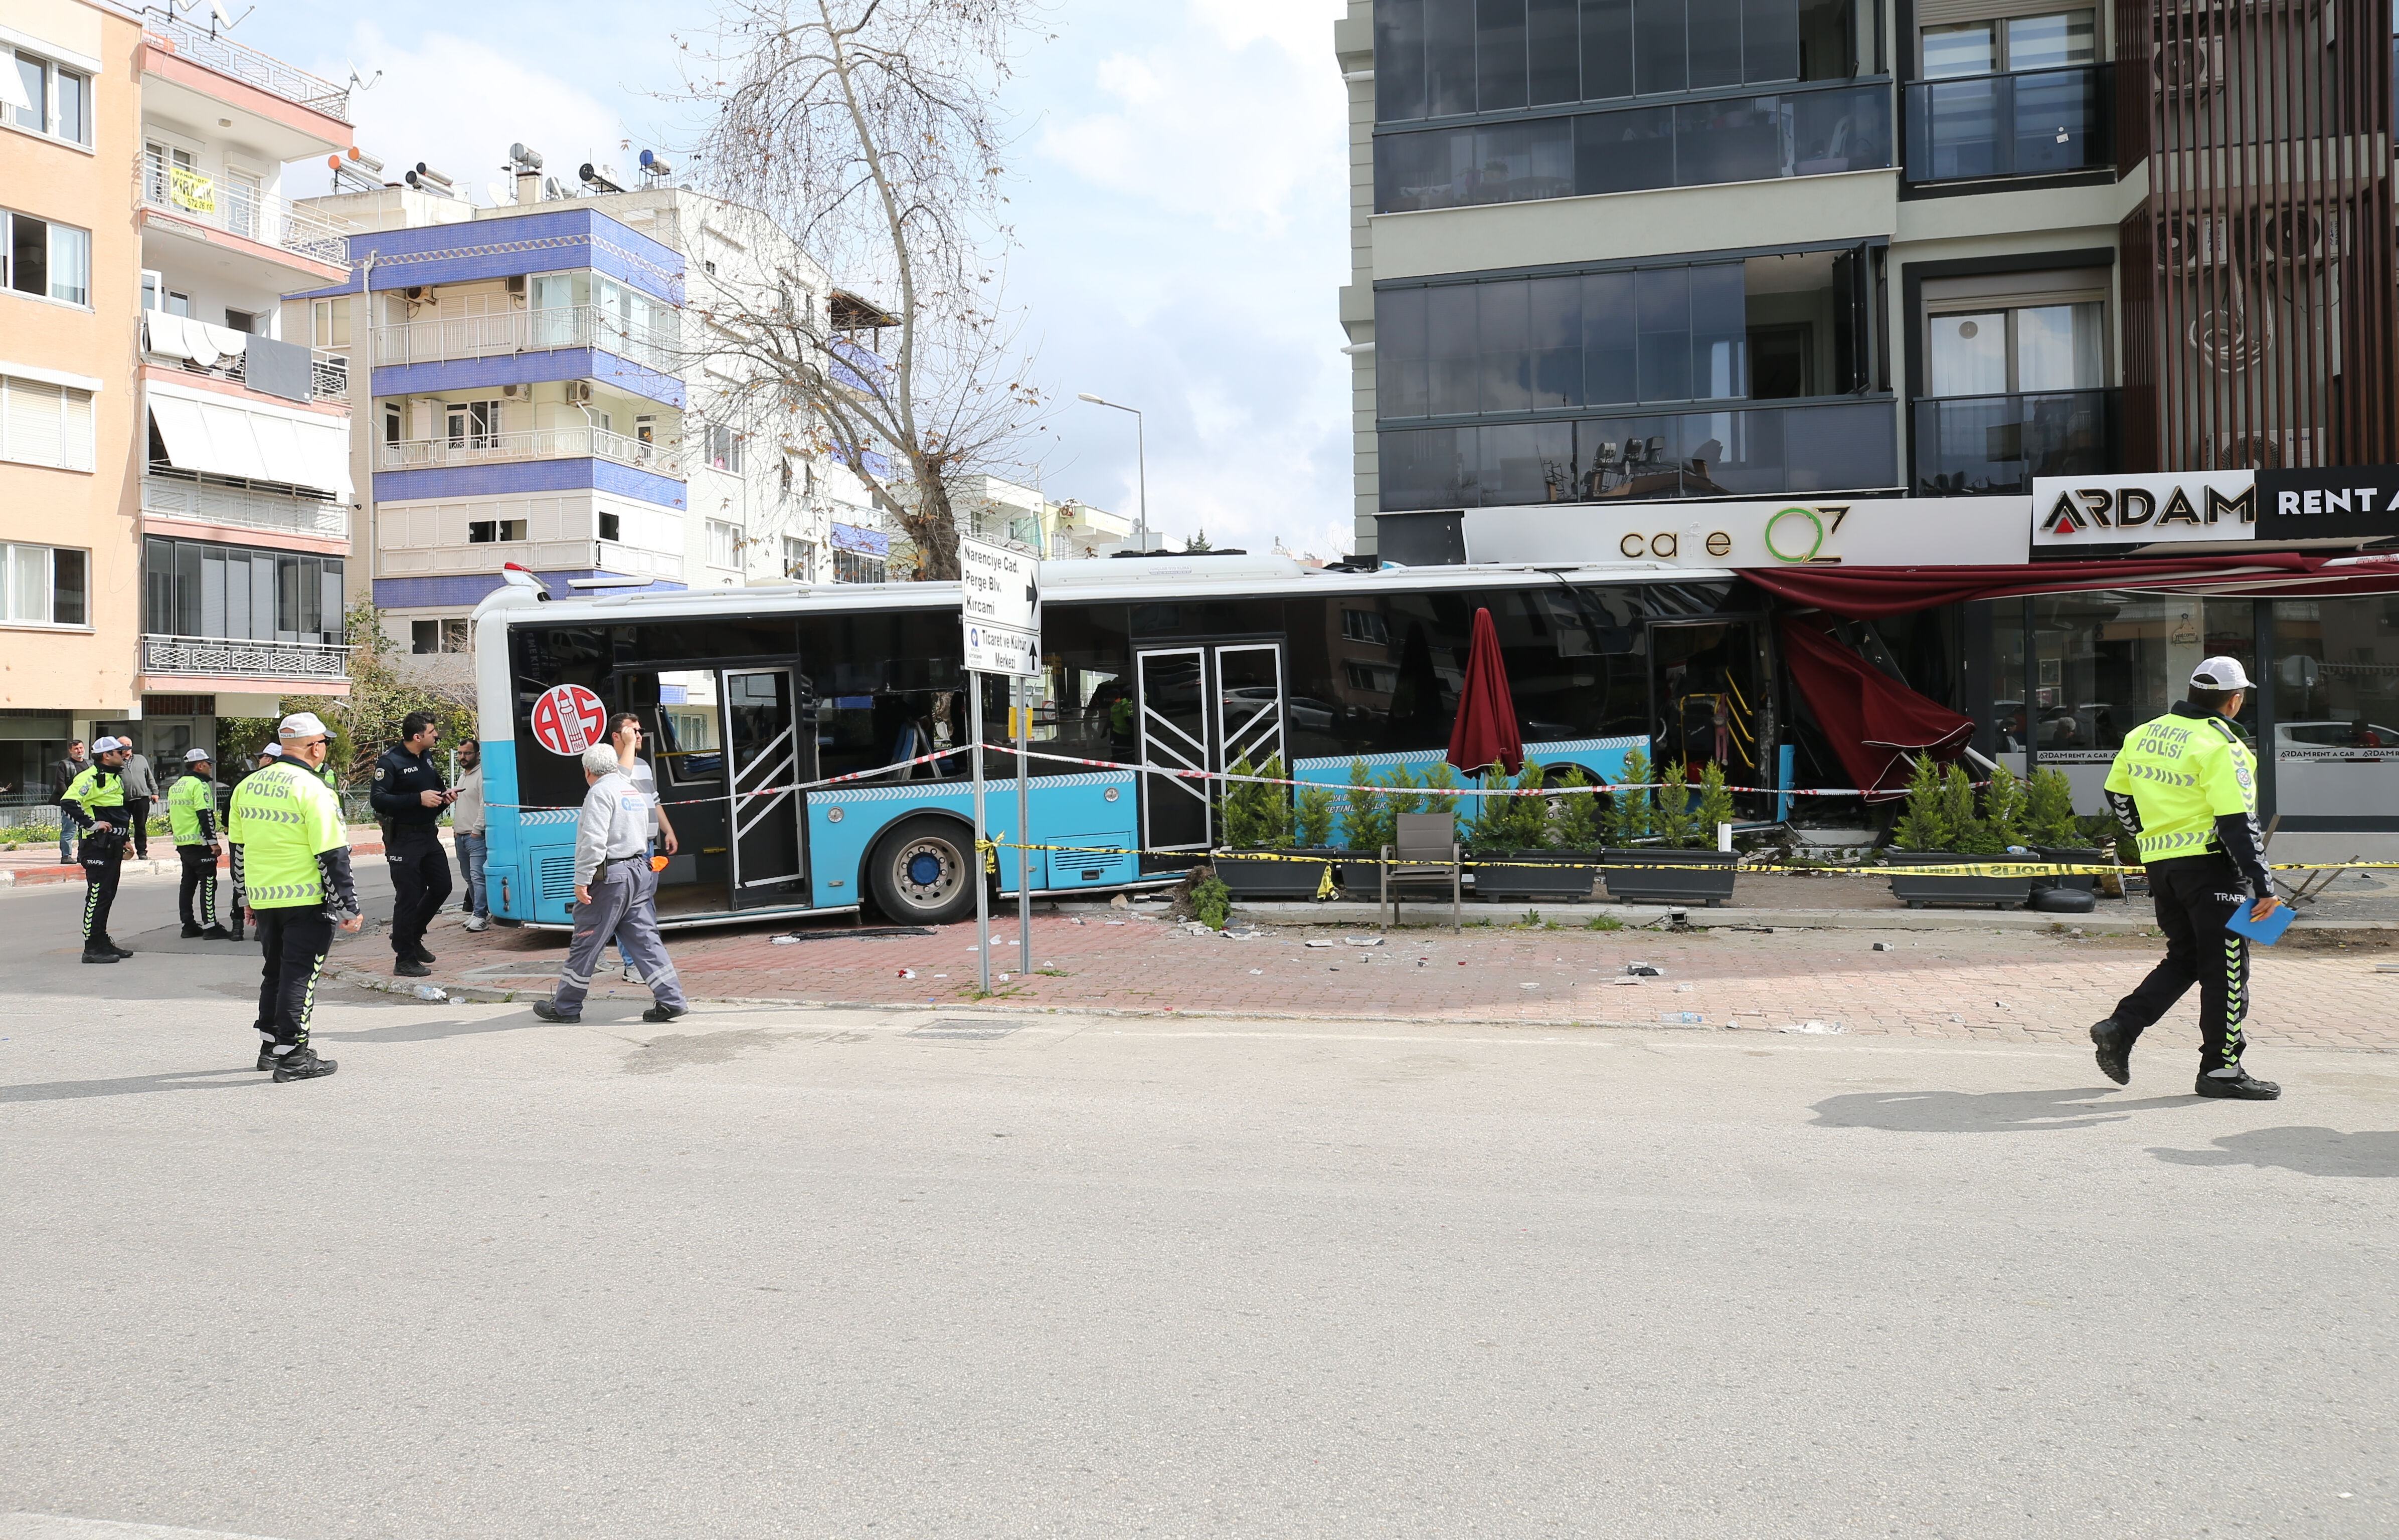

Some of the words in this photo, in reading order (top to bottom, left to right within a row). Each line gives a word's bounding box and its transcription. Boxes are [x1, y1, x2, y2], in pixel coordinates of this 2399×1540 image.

[187, 198, 198, 208] 572
[199, 201, 205, 209] 26
[2039, 483, 2257, 533] ARDAM
[2278, 488, 2377, 515] RENT
[1620, 521, 1732, 558] cafe
[964, 544, 1001, 570] Narenciye
[1003, 556, 1019, 573] Cad.
[965, 569, 986, 592] Perge
[989, 576, 1001, 593] Blv.
[967, 595, 995, 615] Kırcami
[982, 629, 1002, 647] Ticaret
[1003, 637, 1010, 648] ve
[1011, 635, 1026, 651] Kültür
[995, 652, 1015, 669] Merkezi
[2146, 723, 2193, 743] TRAFİK
[2136, 738, 2185, 759] POLİSİ
[253, 770, 298, 785] TRAFİK
[403, 766, 418, 774] POLİS
[245, 782, 290, 799] POLİSİ
